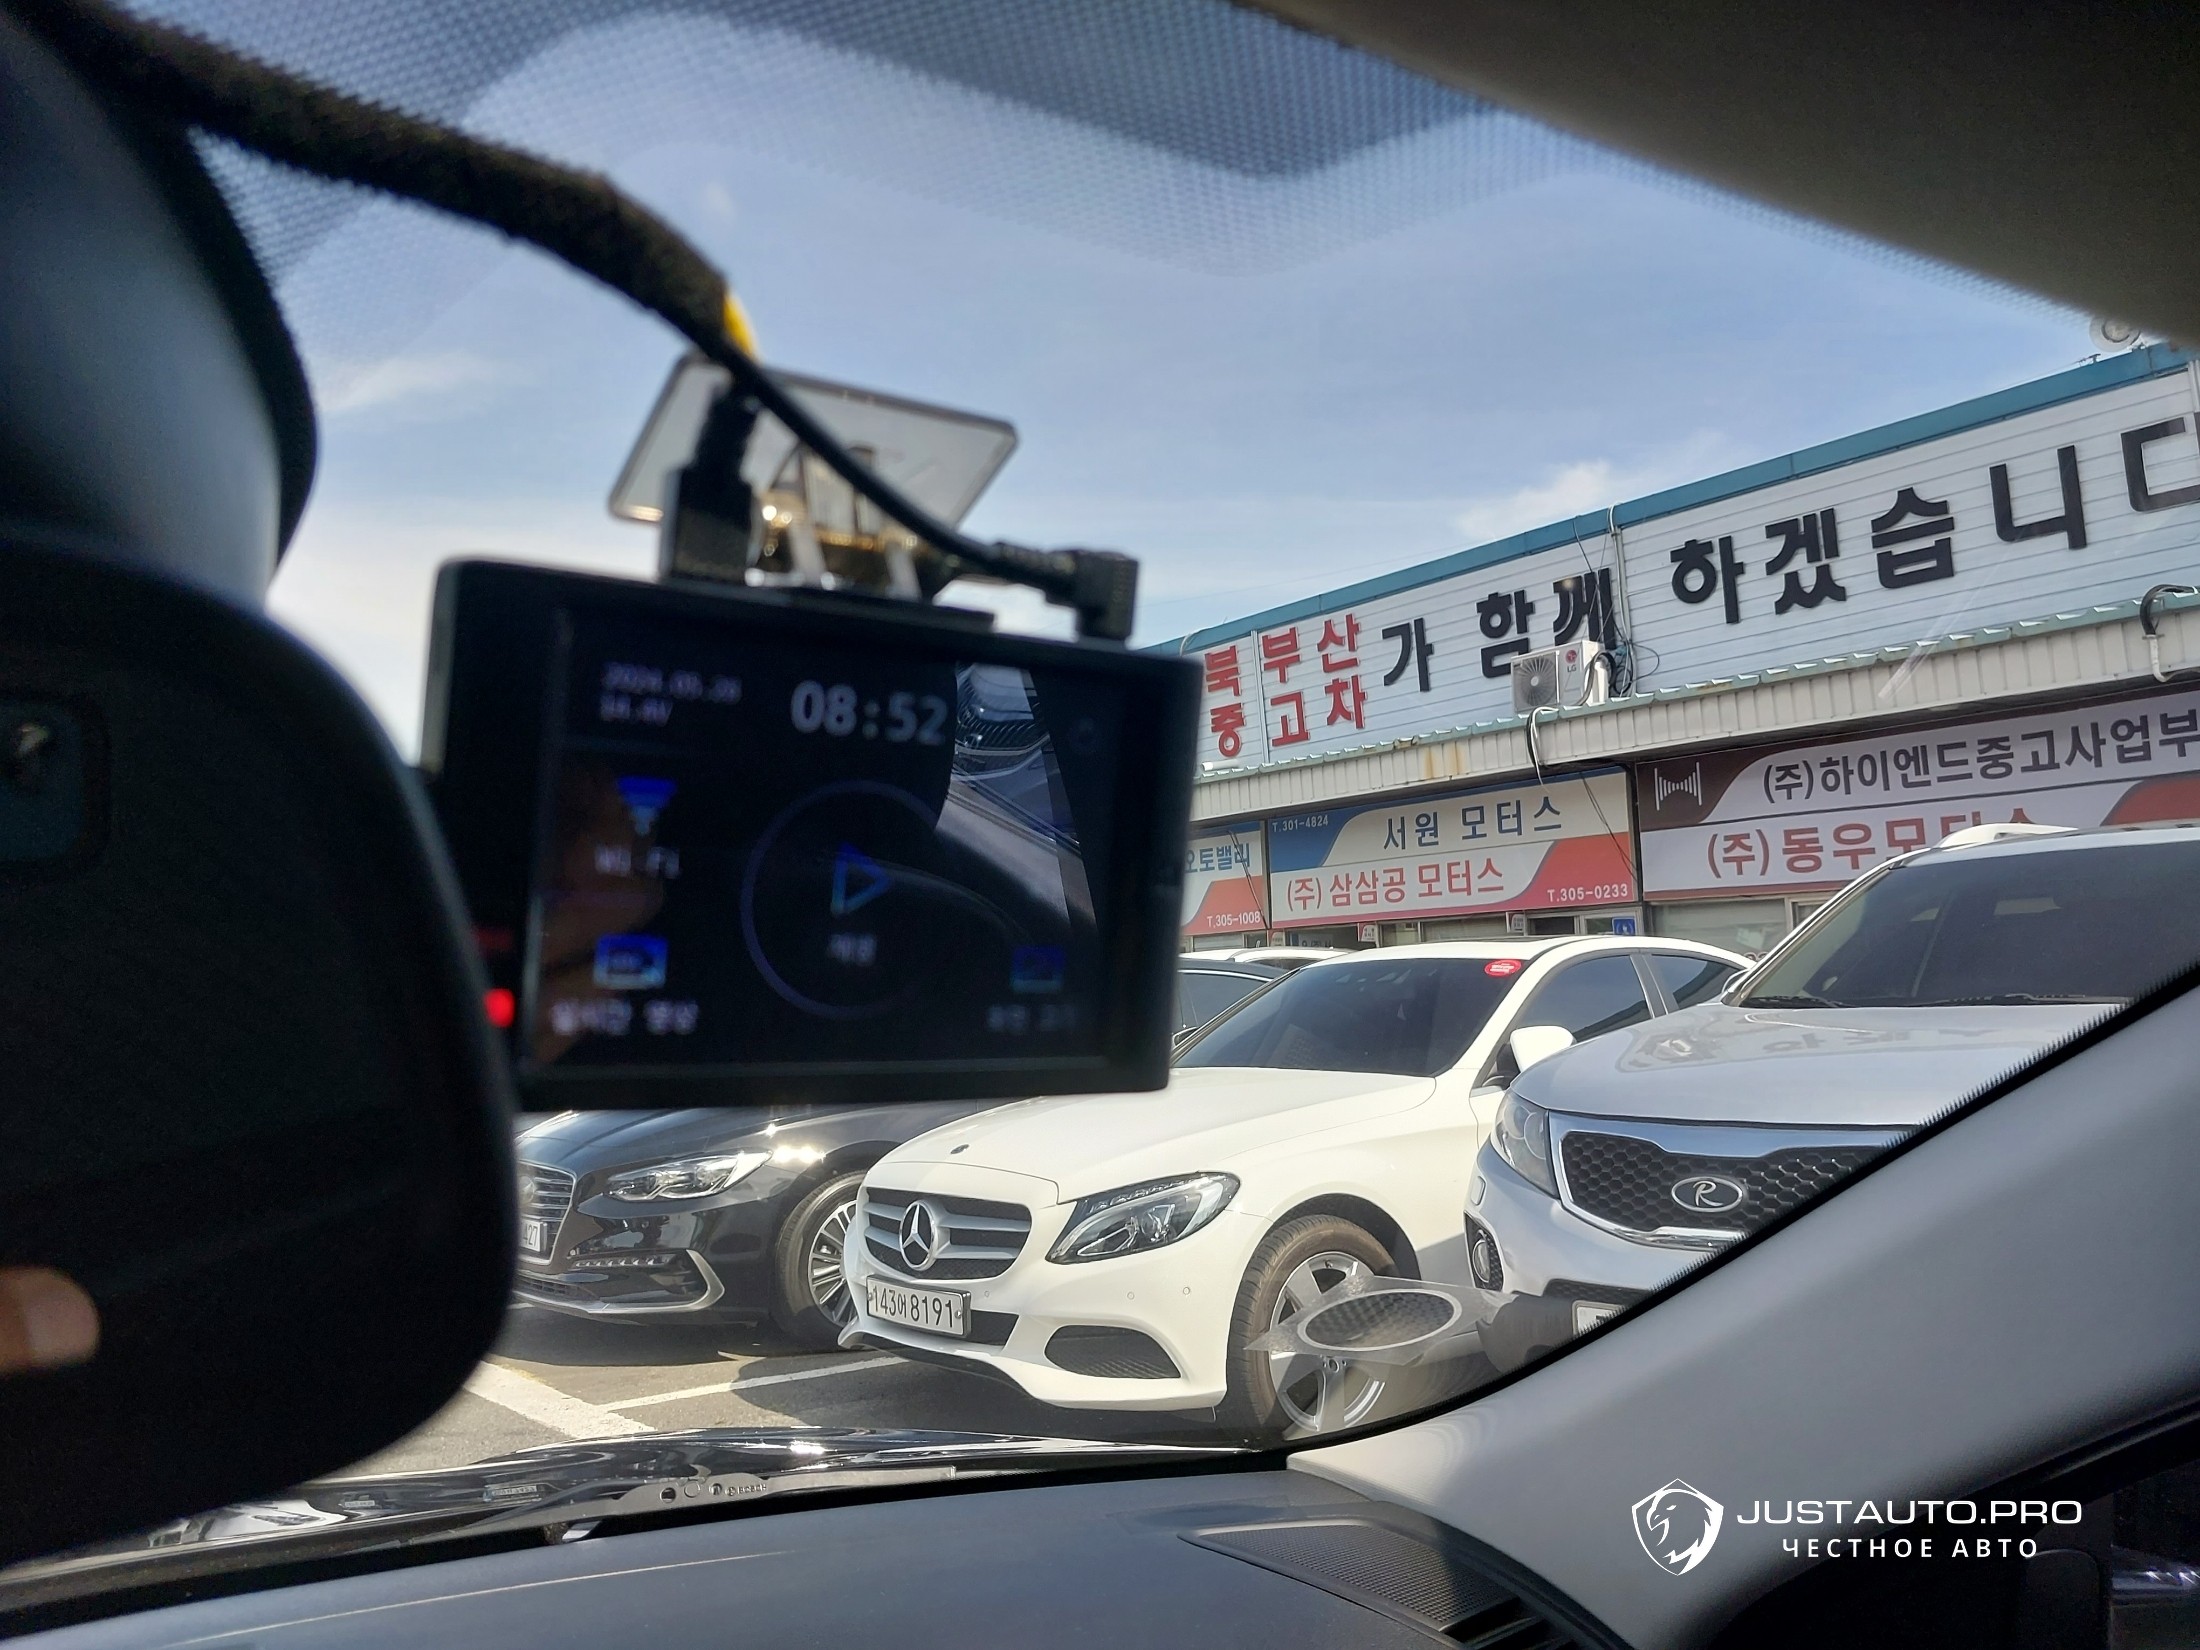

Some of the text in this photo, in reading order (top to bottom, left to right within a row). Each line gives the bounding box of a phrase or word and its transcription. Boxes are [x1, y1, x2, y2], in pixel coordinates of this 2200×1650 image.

[1382, 617, 1434, 692] 가
[1476, 568, 1616, 679] 함께
[1204, 612, 1362, 697] 북부산
[1567, 665, 1577, 673] LG
[790, 680, 947, 746] 08:52
[1211, 674, 1367, 757] 중고차
[1272, 815, 1329, 833] T.301-4824
[1384, 796, 1562, 850] 서원 모터스
[1417, 858, 1504, 898] 모터스
[1547, 884, 1628, 903] T.305-0233
[1207, 911, 1261, 929] T.305-1008
